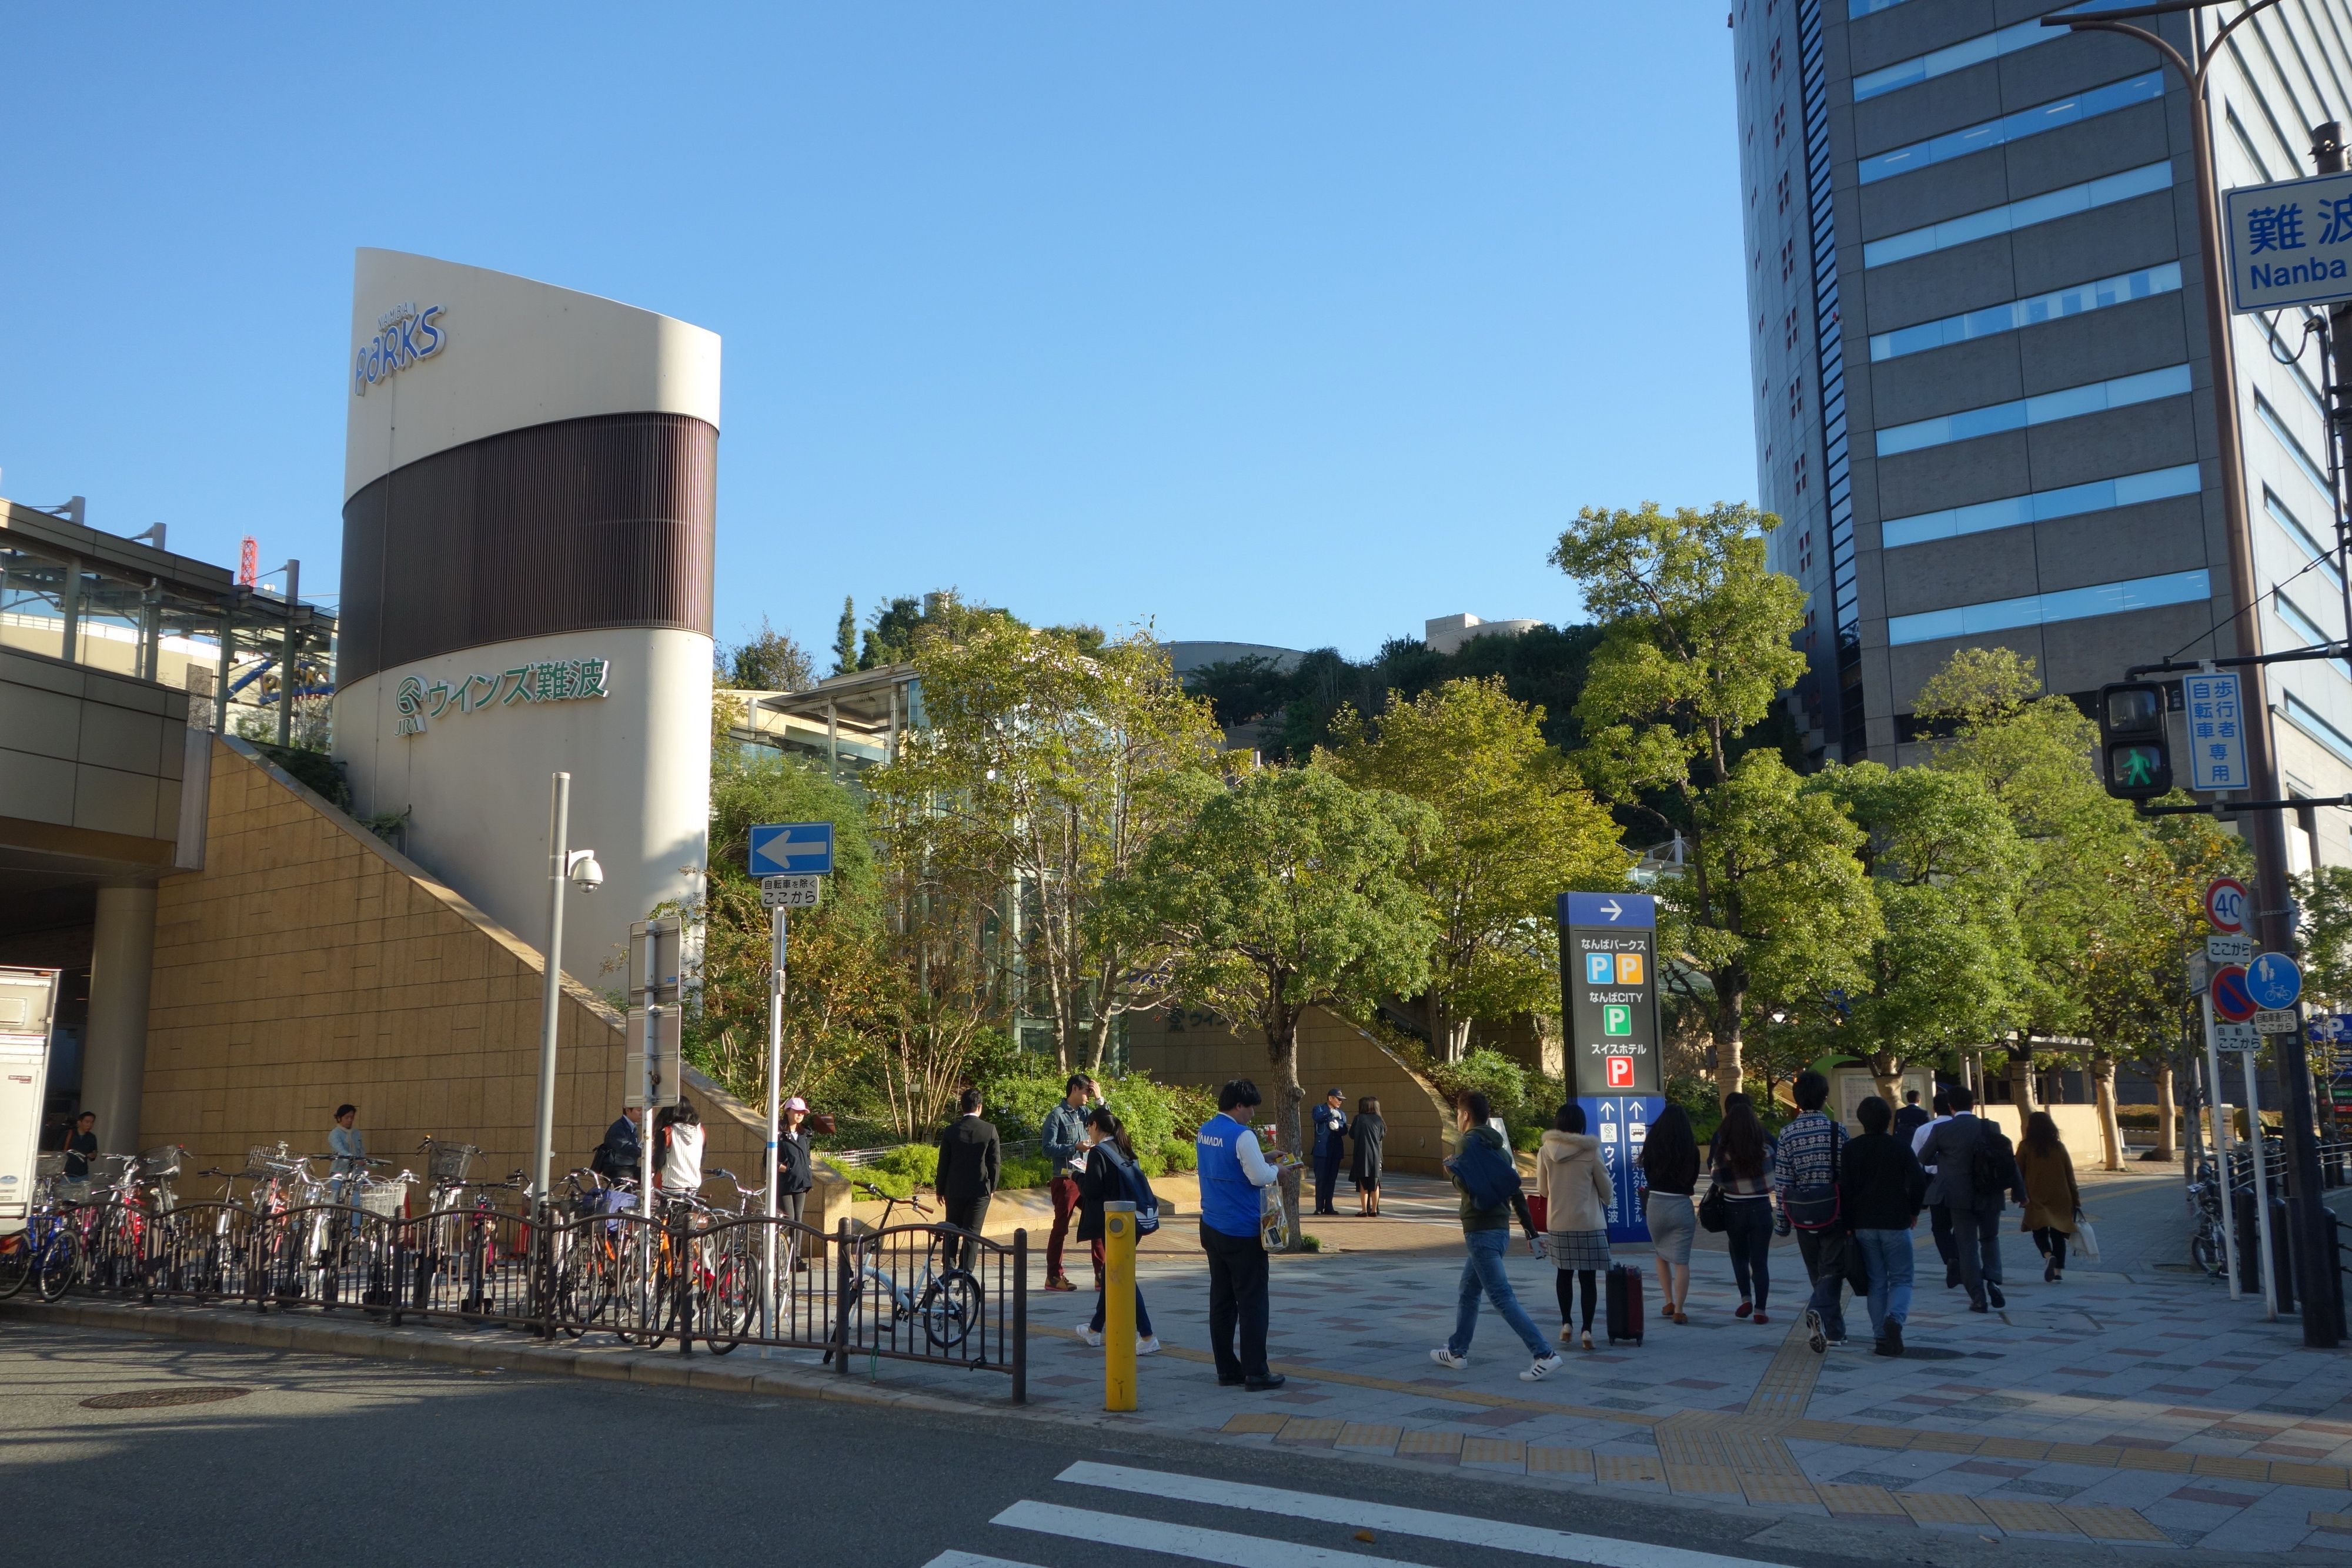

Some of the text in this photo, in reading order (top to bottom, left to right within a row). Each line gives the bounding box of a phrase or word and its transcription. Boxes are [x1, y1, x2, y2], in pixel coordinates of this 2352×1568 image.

[2250, 256, 2347, 290] Nanba
[377, 302, 409, 328] NAMBA
[427, 657, 607, 718] ウインズ難波
[2193, 682, 2215, 739] 自転車
[2214, 681, 2236, 738] 歩行者
[394, 717, 419, 737] JRA
[2209, 743, 2230, 783] 専用
[764, 878, 816, 890] 自転車を除く
[764, 891, 816, 904] ここから
[2214, 893, 2242, 918] 40
[1581, 938, 1646, 951] なんばパークス
[2211, 942, 2250, 956] ここから
[1591, 957, 1638, 981] P P
[1589, 992, 1643, 1003] なんばCITY
[1609, 1008, 1626, 1032] P
[2260, 1023, 2293, 1032] ここから
[1591, 1044, 1646, 1055] スイスホテル
[2219, 1038, 2261, 1049] ここから
[1612, 1059, 1629, 1084] P
[1197, 1131, 1223, 1148] YAMADA
